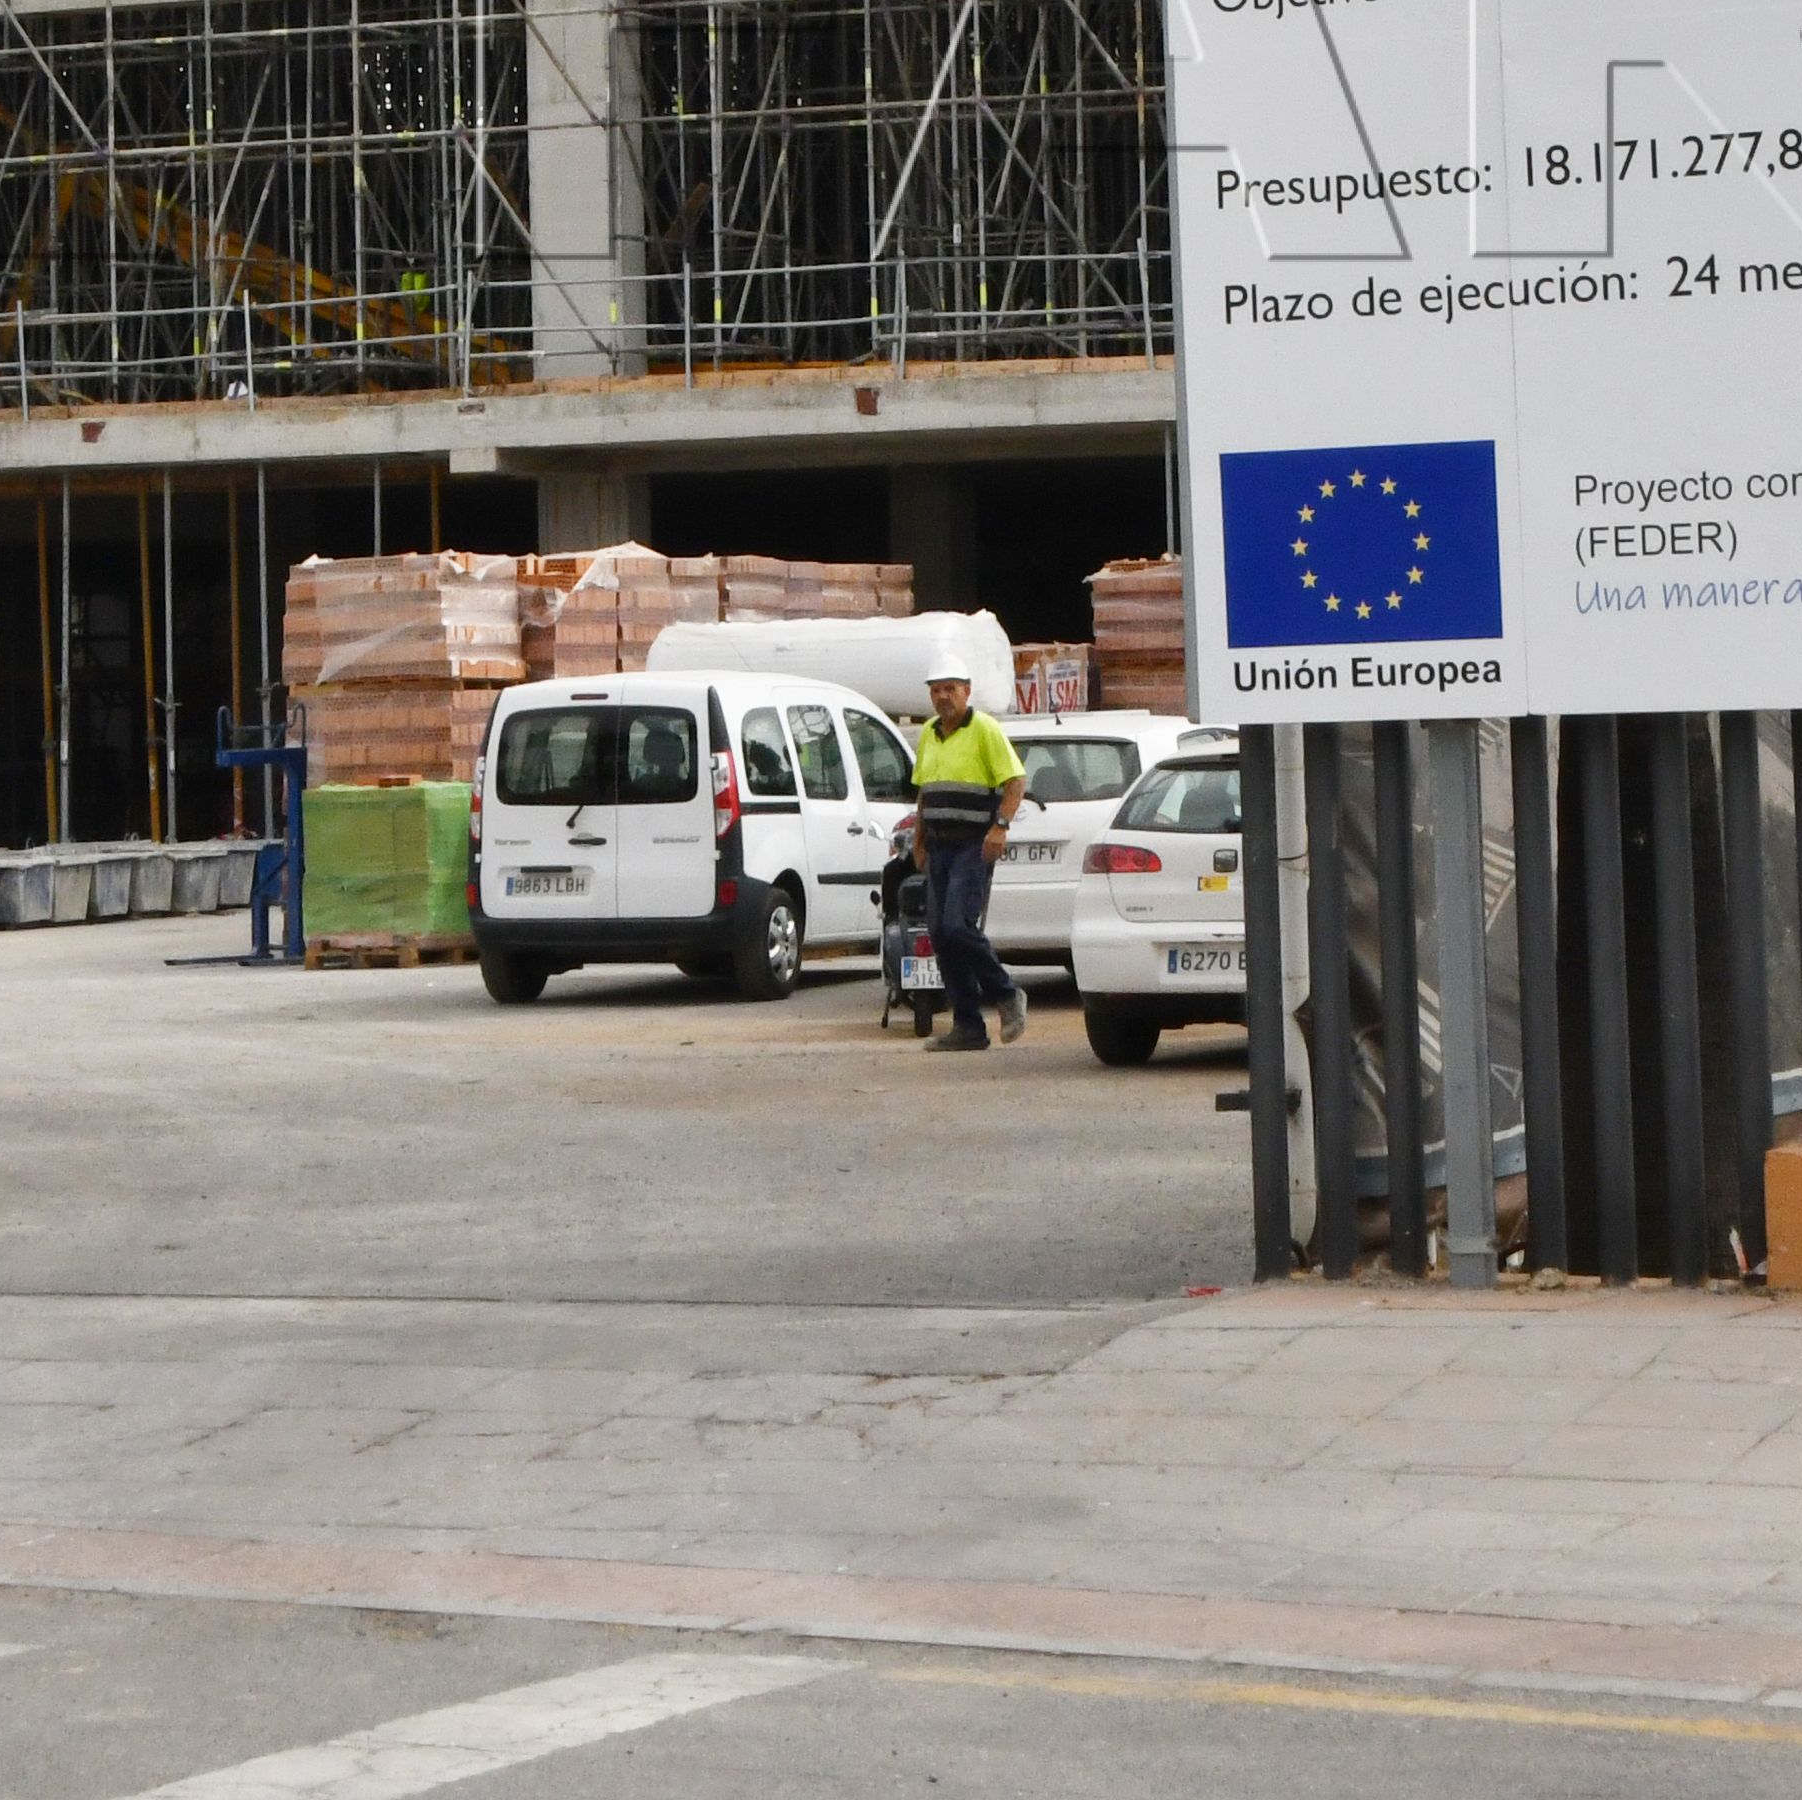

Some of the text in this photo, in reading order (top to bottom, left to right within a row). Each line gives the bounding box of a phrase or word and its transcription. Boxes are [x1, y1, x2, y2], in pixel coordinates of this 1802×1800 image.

[1217, 161, 1493, 214] Presupuesto:
[1224, 284, 1334, 325] Plazo
[1351, 277, 1403, 318] de
[1419, 262, 1639, 324] ejecución:
[1666, 254, 1720, 298] 24
[1574, 470, 1733, 512] Proyecto
[1575, 521, 1738, 567] (FEDER)
[1575, 579, 1646, 614] Una
[1233, 653, 1502, 694] Unión Europea
[1181, 951, 1231, 971] 6270
